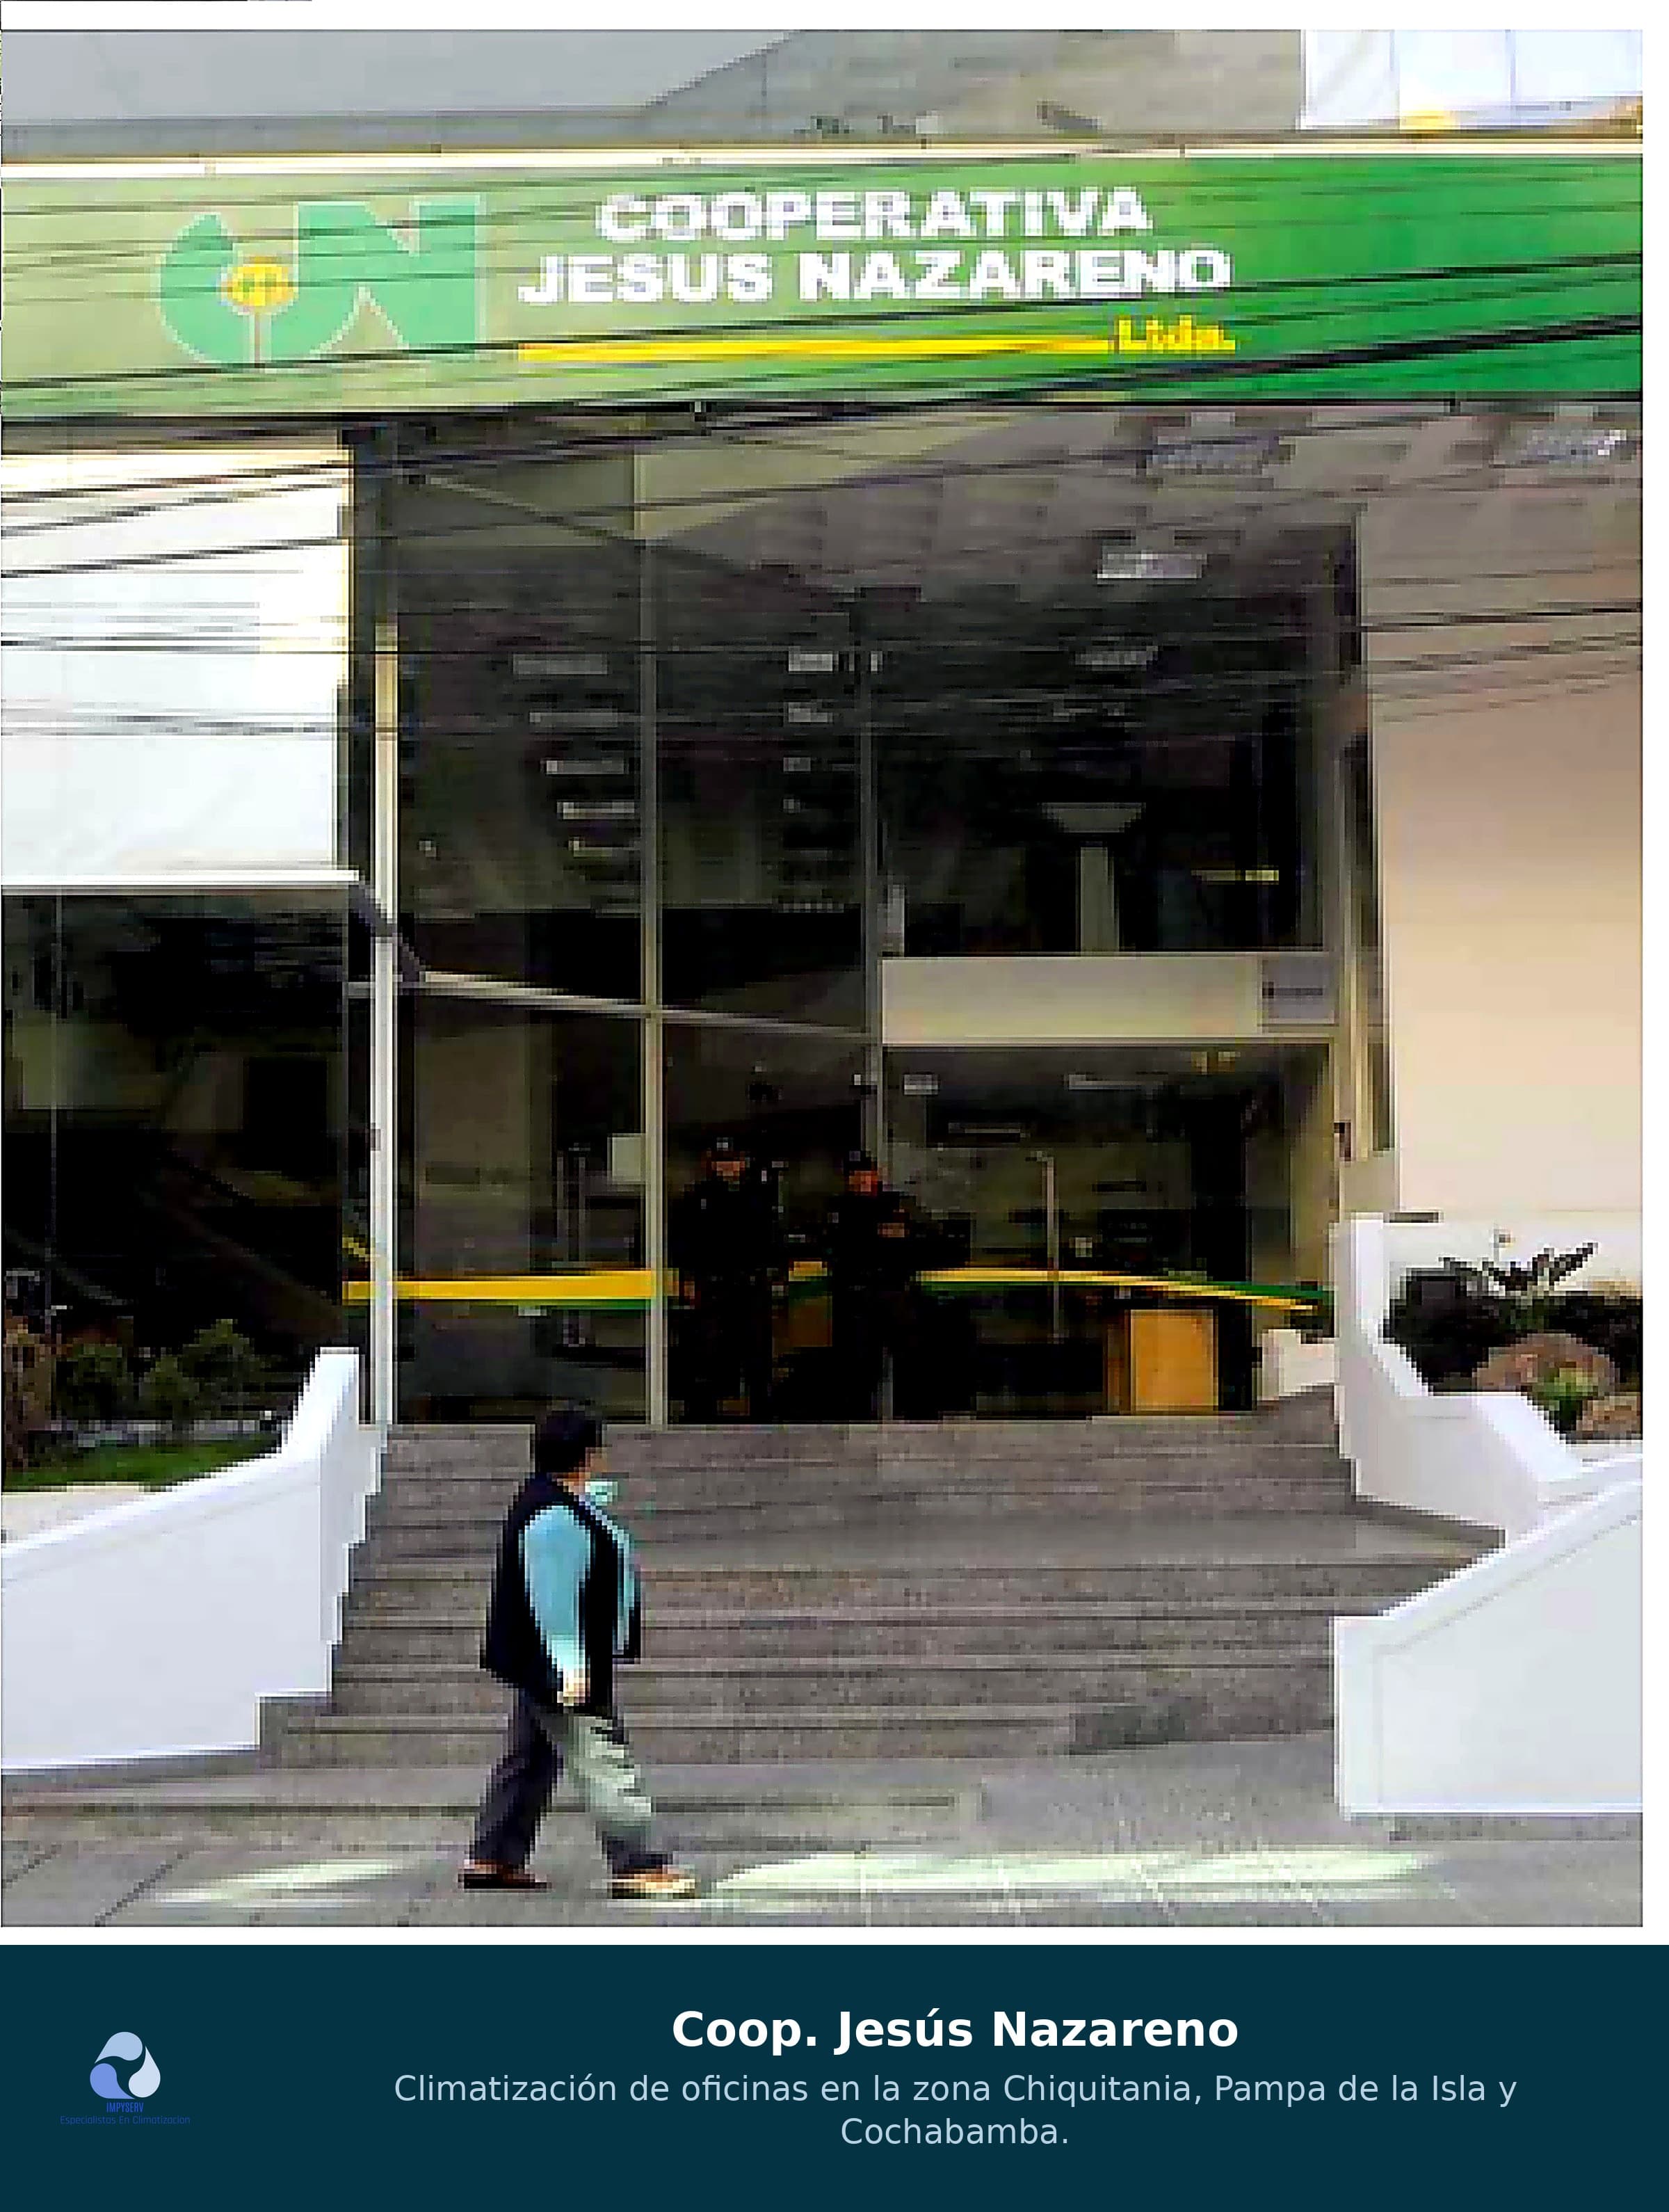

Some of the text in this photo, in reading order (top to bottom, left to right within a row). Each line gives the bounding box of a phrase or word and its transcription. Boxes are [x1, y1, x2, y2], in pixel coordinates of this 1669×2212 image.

[596, 186, 1153, 242] COOPERATIVA
[517, 248, 1234, 304] JESUS NAZARENO
